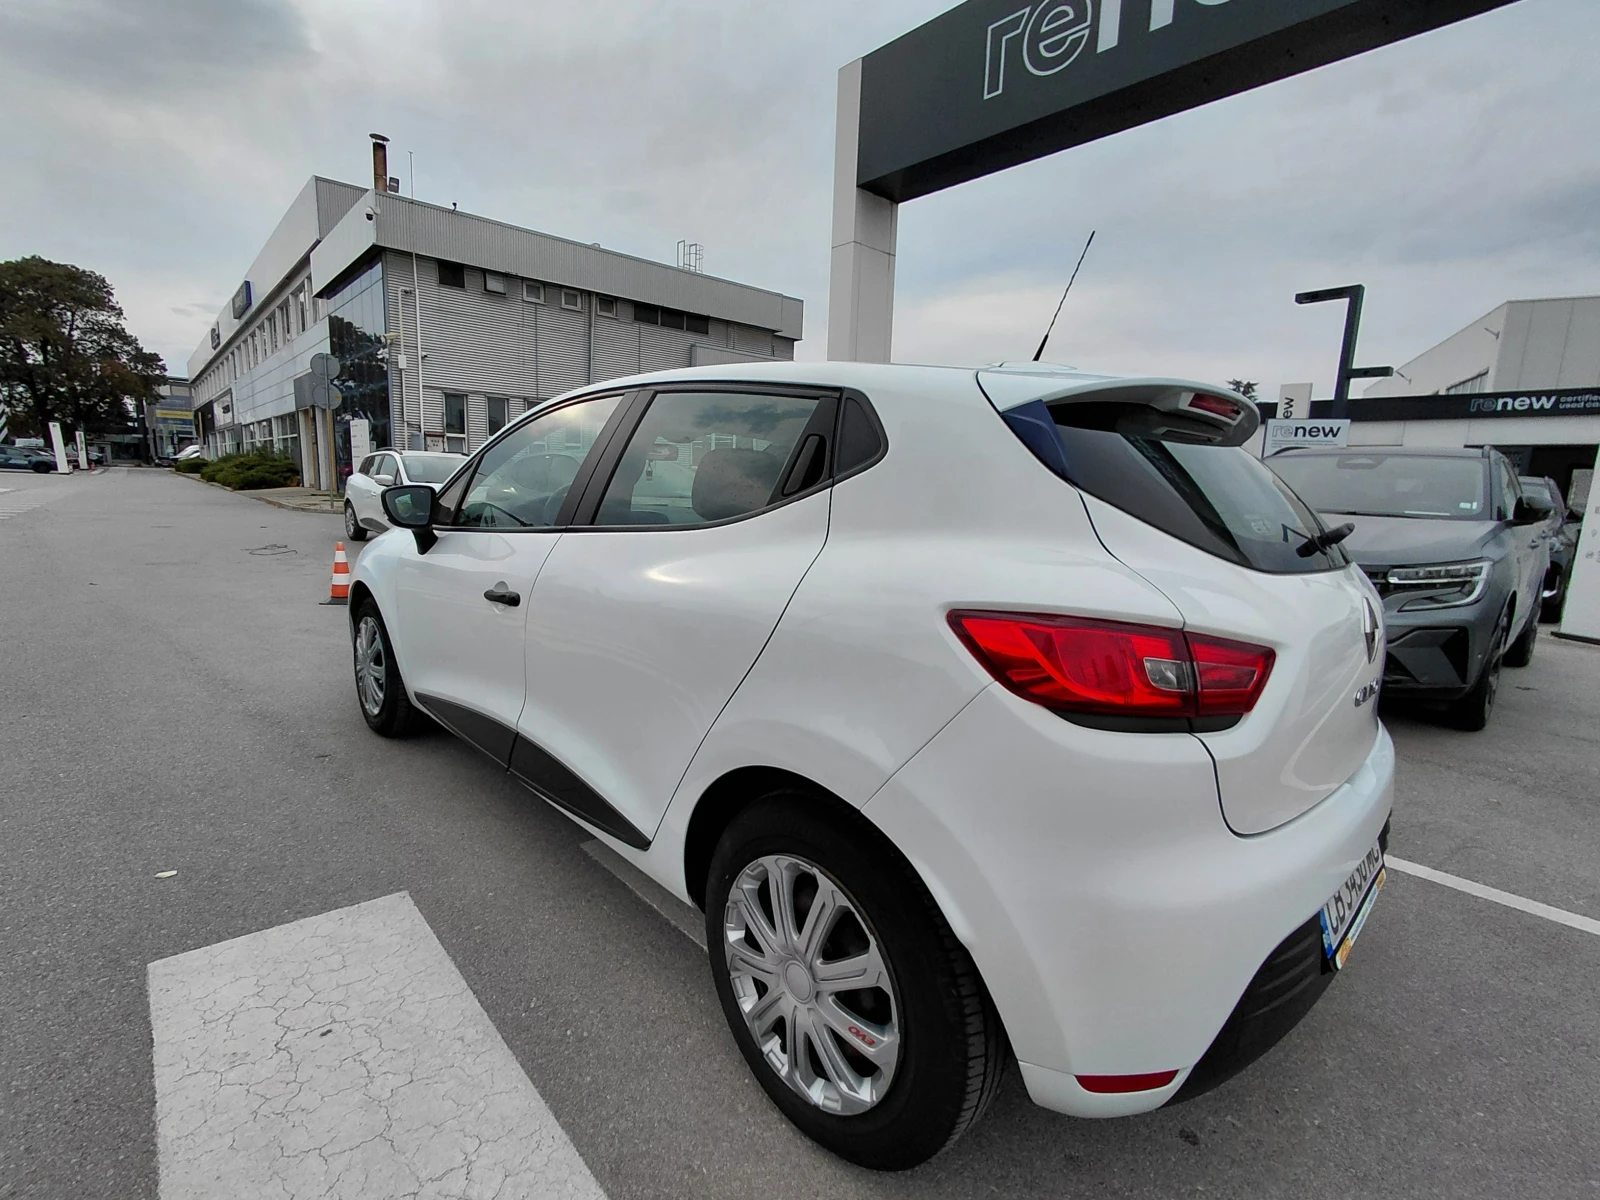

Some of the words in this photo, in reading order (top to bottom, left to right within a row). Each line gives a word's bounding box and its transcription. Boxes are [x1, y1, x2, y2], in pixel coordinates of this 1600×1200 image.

[1469, 395, 1557, 412] renew
[1560, 394, 1600, 402] certifie
[1272, 425, 1341, 438] renew
[848, 1026, 876, 1045] EVO
